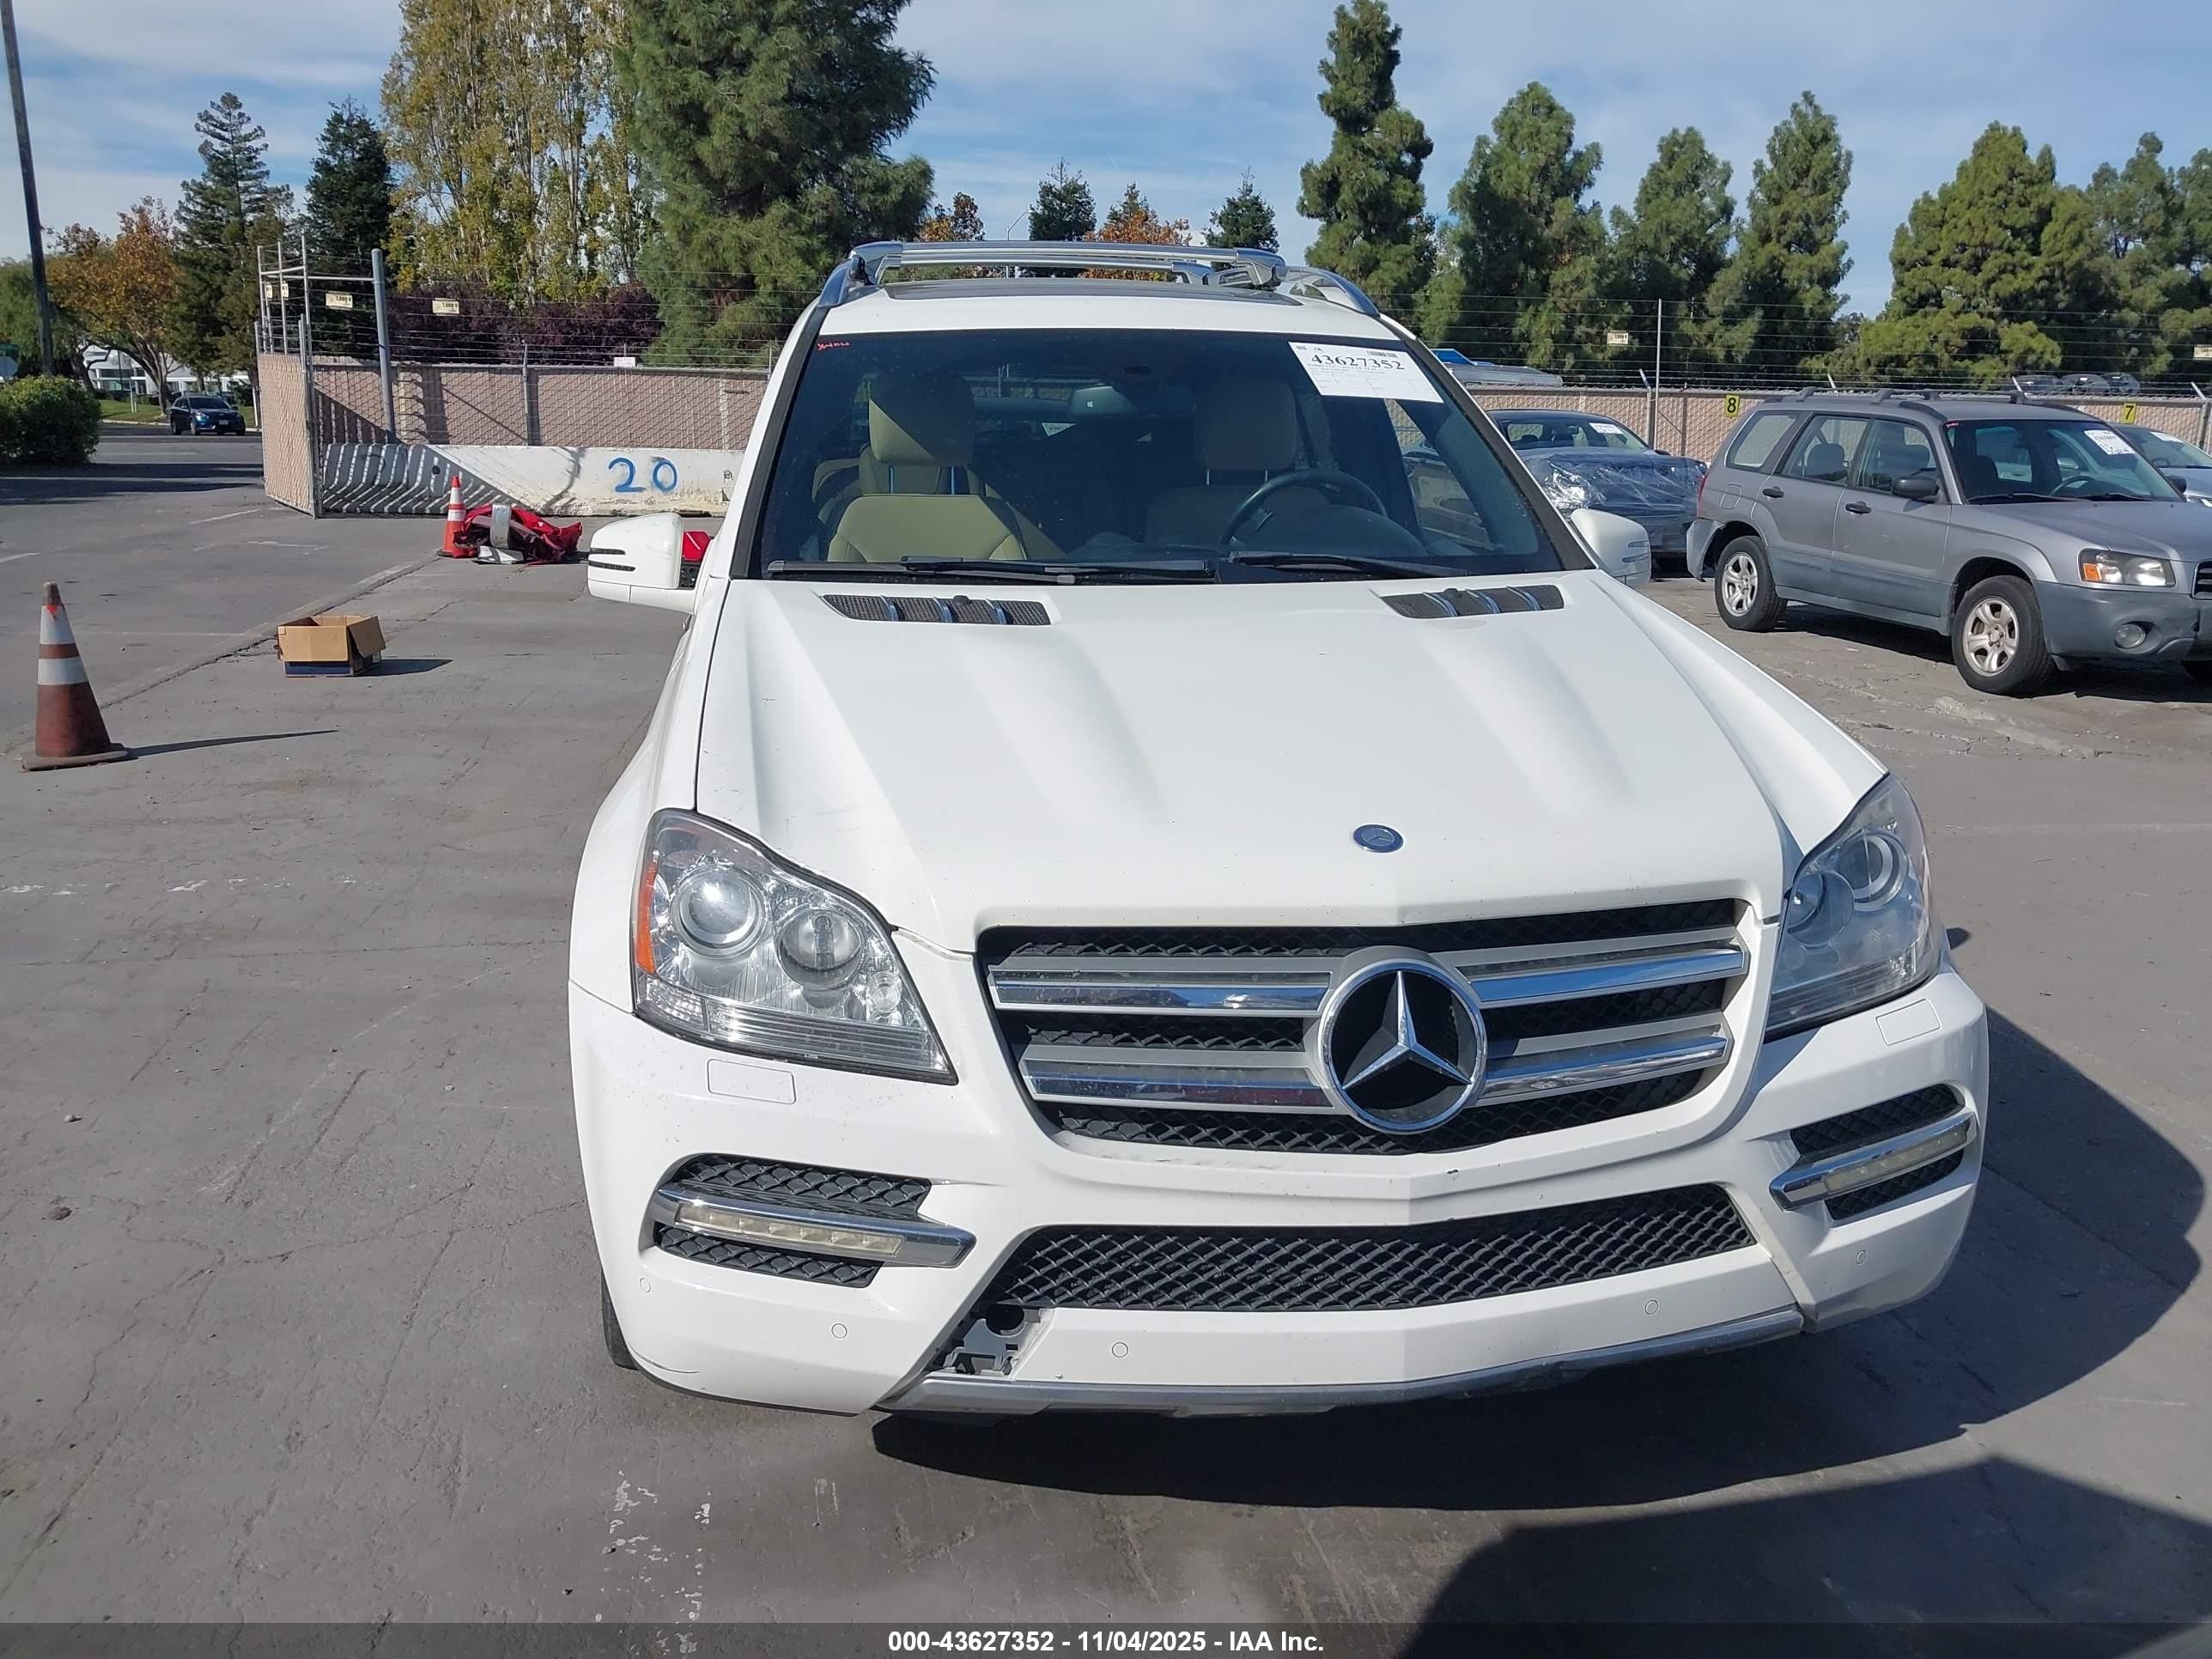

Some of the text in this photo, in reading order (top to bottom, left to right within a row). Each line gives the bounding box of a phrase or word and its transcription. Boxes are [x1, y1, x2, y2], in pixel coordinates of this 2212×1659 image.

[1311, 355, 1406, 370] 43627352
[1727, 397, 1736, 413] 8
[2125, 404, 2135, 420] 7
[608, 457, 678, 495] 20
